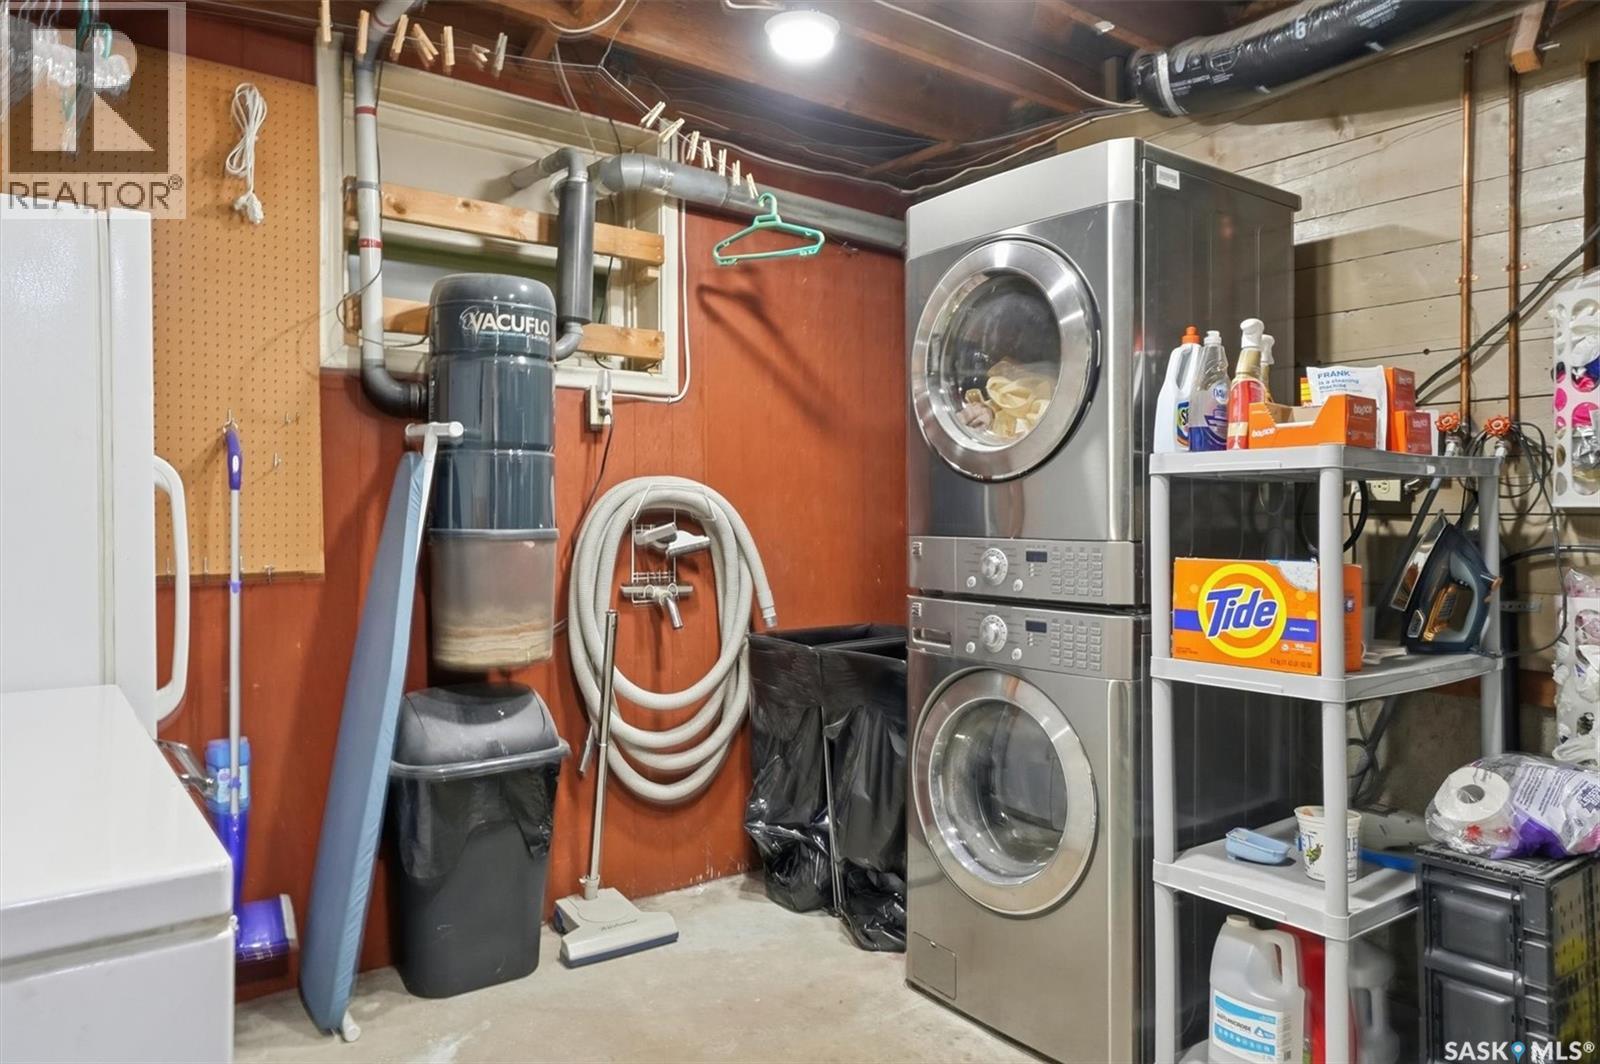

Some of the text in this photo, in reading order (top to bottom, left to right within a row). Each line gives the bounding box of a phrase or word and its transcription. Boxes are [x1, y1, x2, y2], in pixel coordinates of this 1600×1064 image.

[470, 311, 550, 337] VACUFLO
[1317, 370, 1351, 379] FRANK
[1206, 587, 1278, 638] Tide
